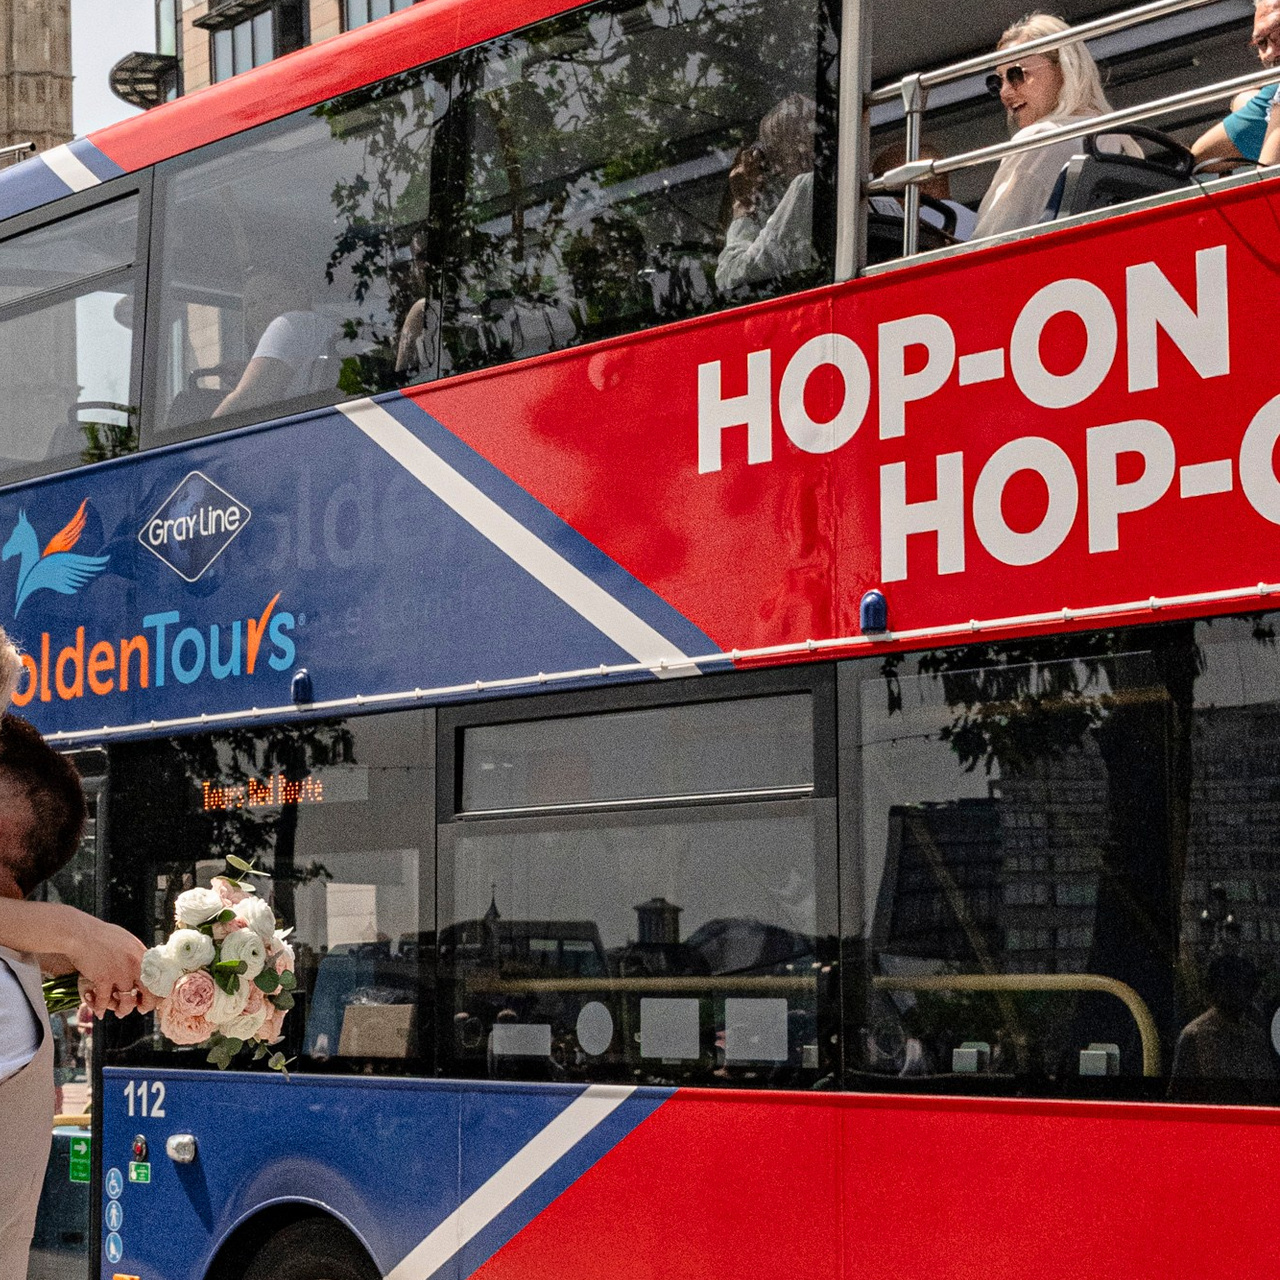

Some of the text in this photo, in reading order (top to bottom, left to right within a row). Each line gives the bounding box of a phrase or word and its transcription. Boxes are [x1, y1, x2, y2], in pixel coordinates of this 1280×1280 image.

[697, 244, 1231, 475] HOP-ON
[248, 774, 274, 808] Red
[277, 774, 323, 804] Route
[123, 1080, 166, 1118] 112
